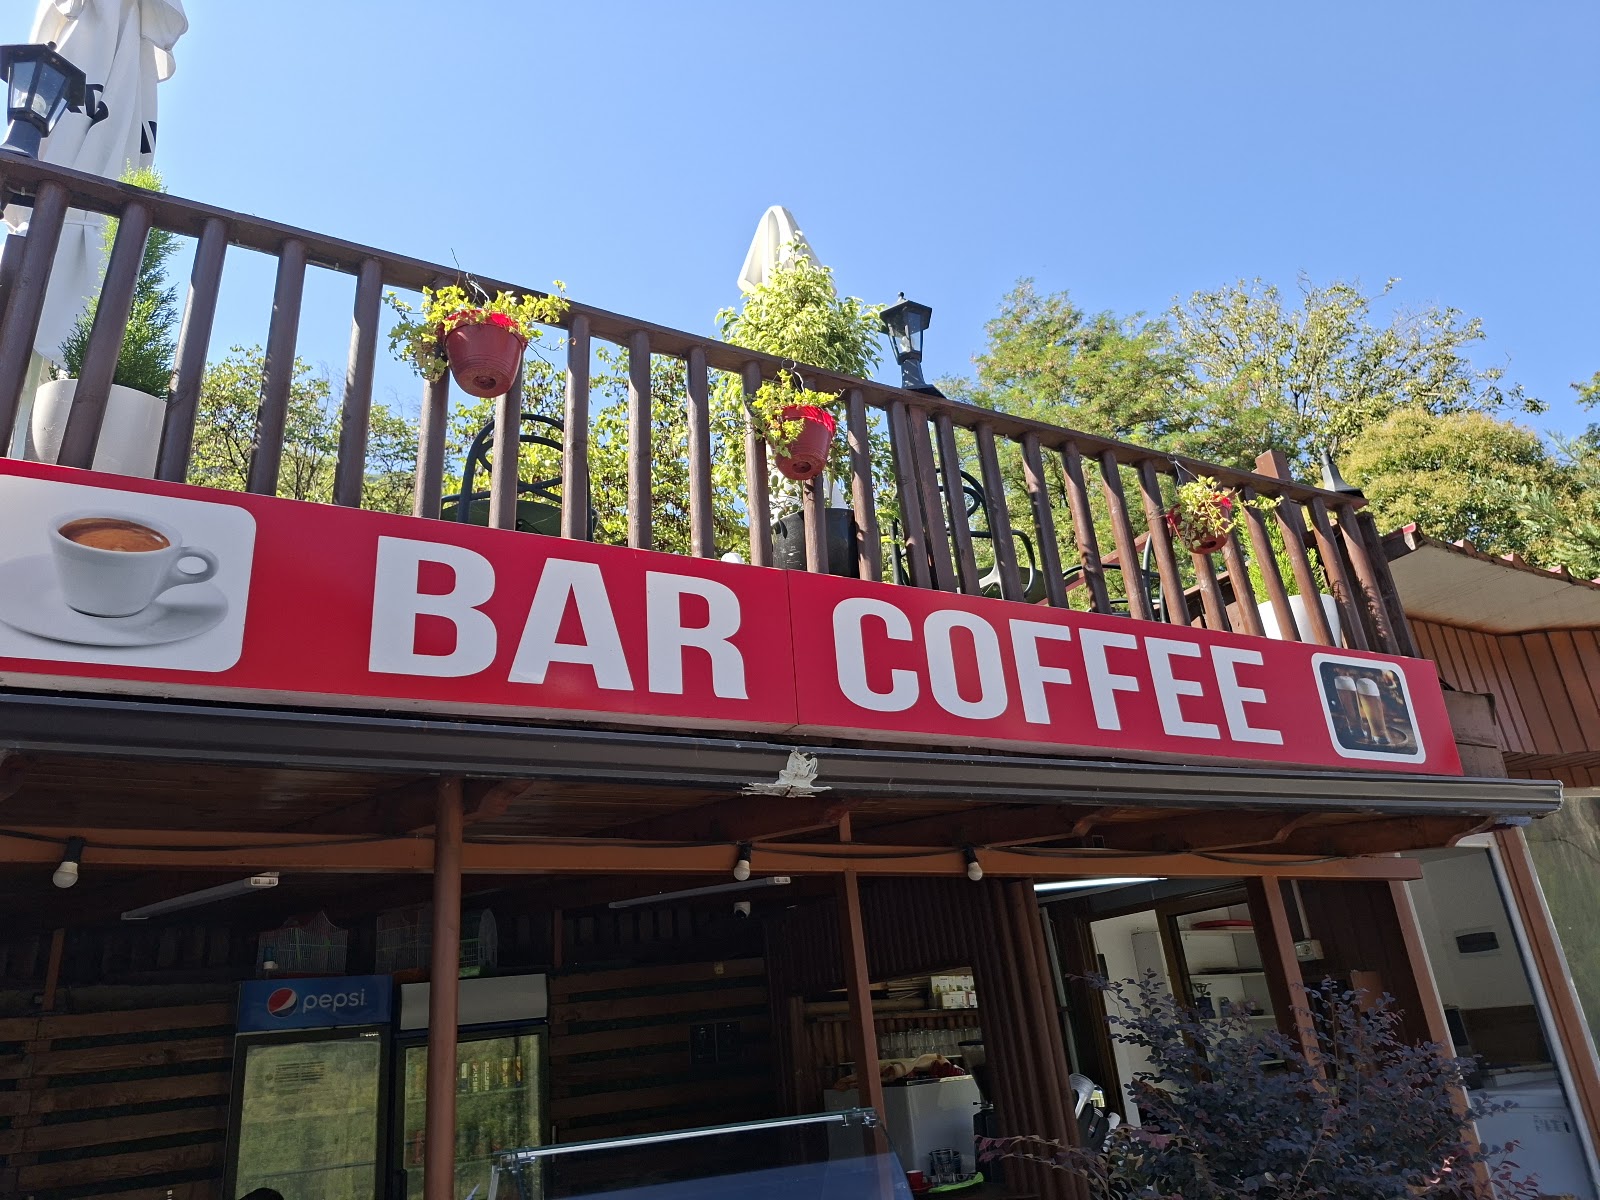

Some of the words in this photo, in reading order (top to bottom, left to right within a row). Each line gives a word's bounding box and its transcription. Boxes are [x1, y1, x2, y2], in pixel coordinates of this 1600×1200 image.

[368, 535, 749, 700] BAR
[832, 597, 1284, 745] COFFEE
[302, 988, 366, 1014] pepsi
